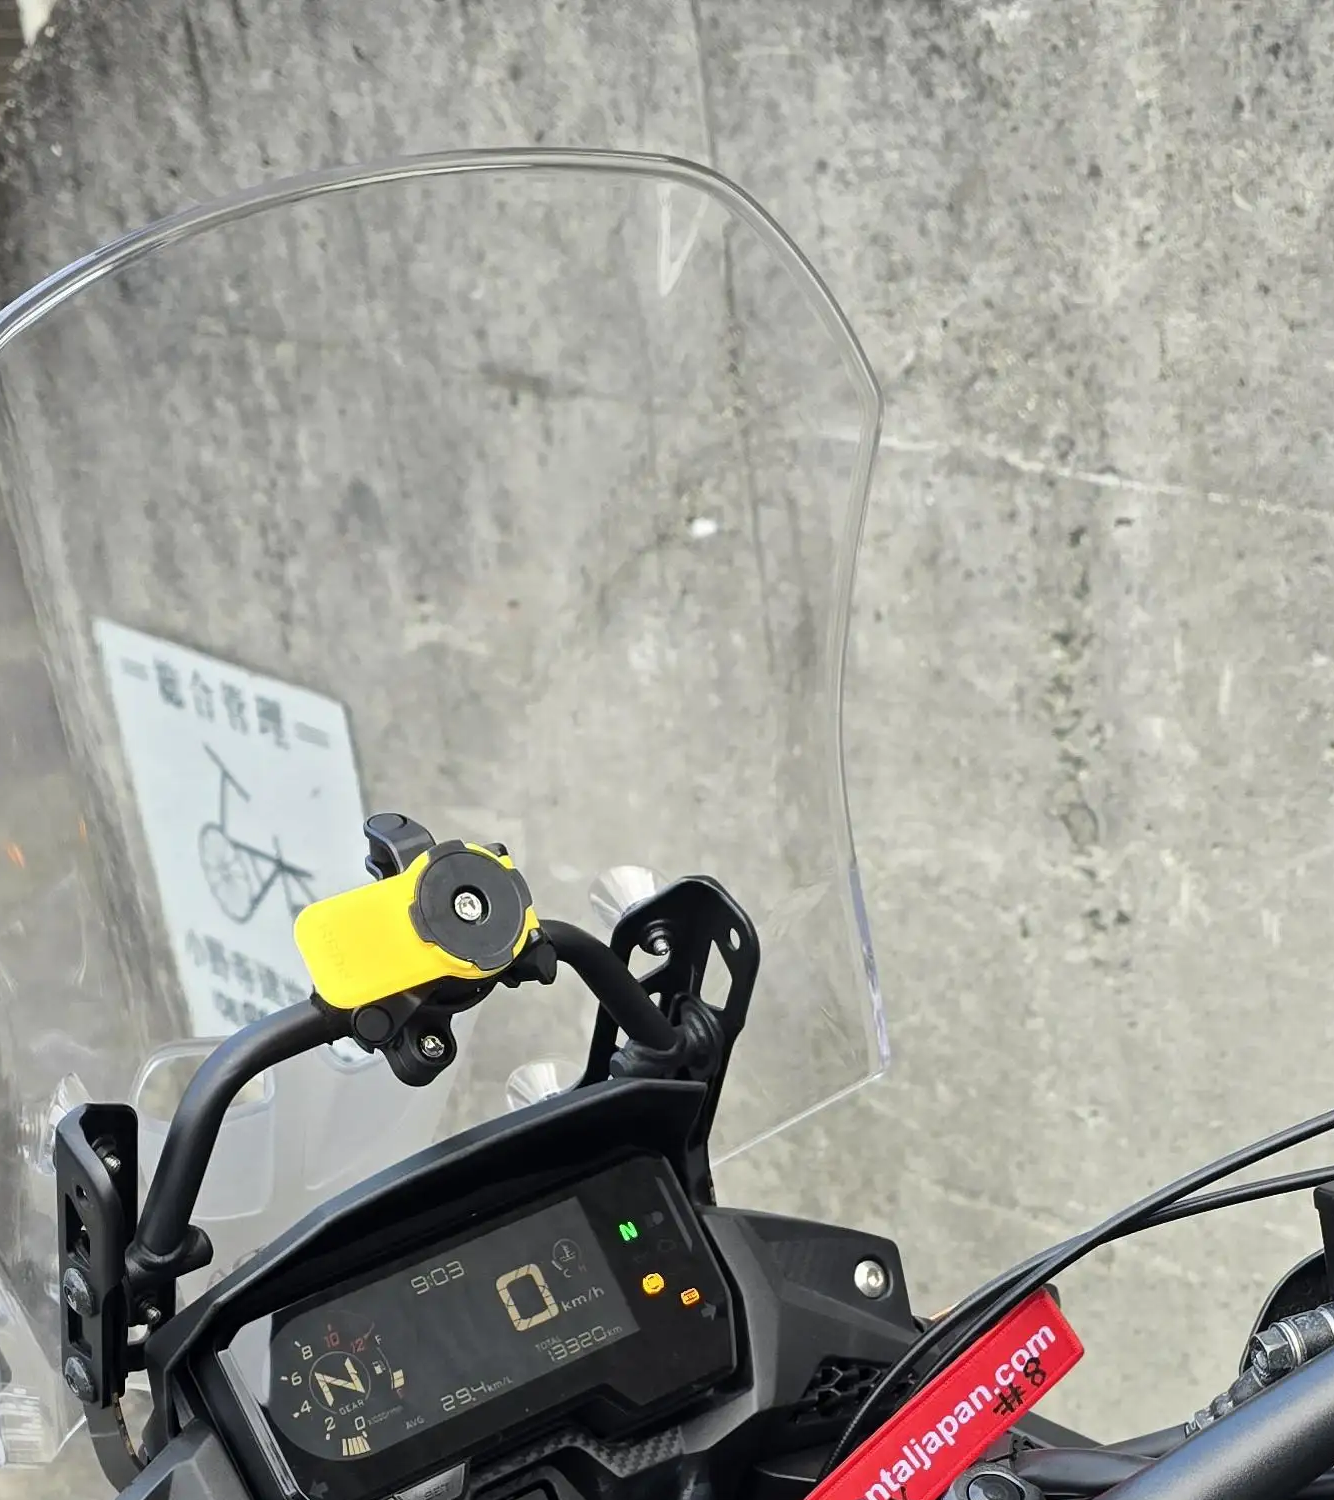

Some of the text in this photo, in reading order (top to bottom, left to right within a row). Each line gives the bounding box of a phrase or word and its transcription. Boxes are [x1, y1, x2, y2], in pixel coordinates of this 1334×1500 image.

[619, 1222, 638, 1241] N
[411, 1261, 465, 1295] 9:03
[496, 1263, 605, 1331] 0 km/h
[324, 1333, 340, 1348] 10
[350, 1338, 365, 1353] 12
[536, 1335, 561, 1352] TOTAL
[548, 1325, 608, 1362] 13320
[301, 1345, 313, 1360] 8
[291, 1371, 302, 1386] 6
[314, 1357, 366, 1407] N
[300, 1400, 312, 1413] 4
[339, 1399, 365, 1416] GEAR
[405, 1416, 425, 1430] AVG
[440, 1380, 487, 1412] 29.4
[325, 1416, 336, 1431] 2
